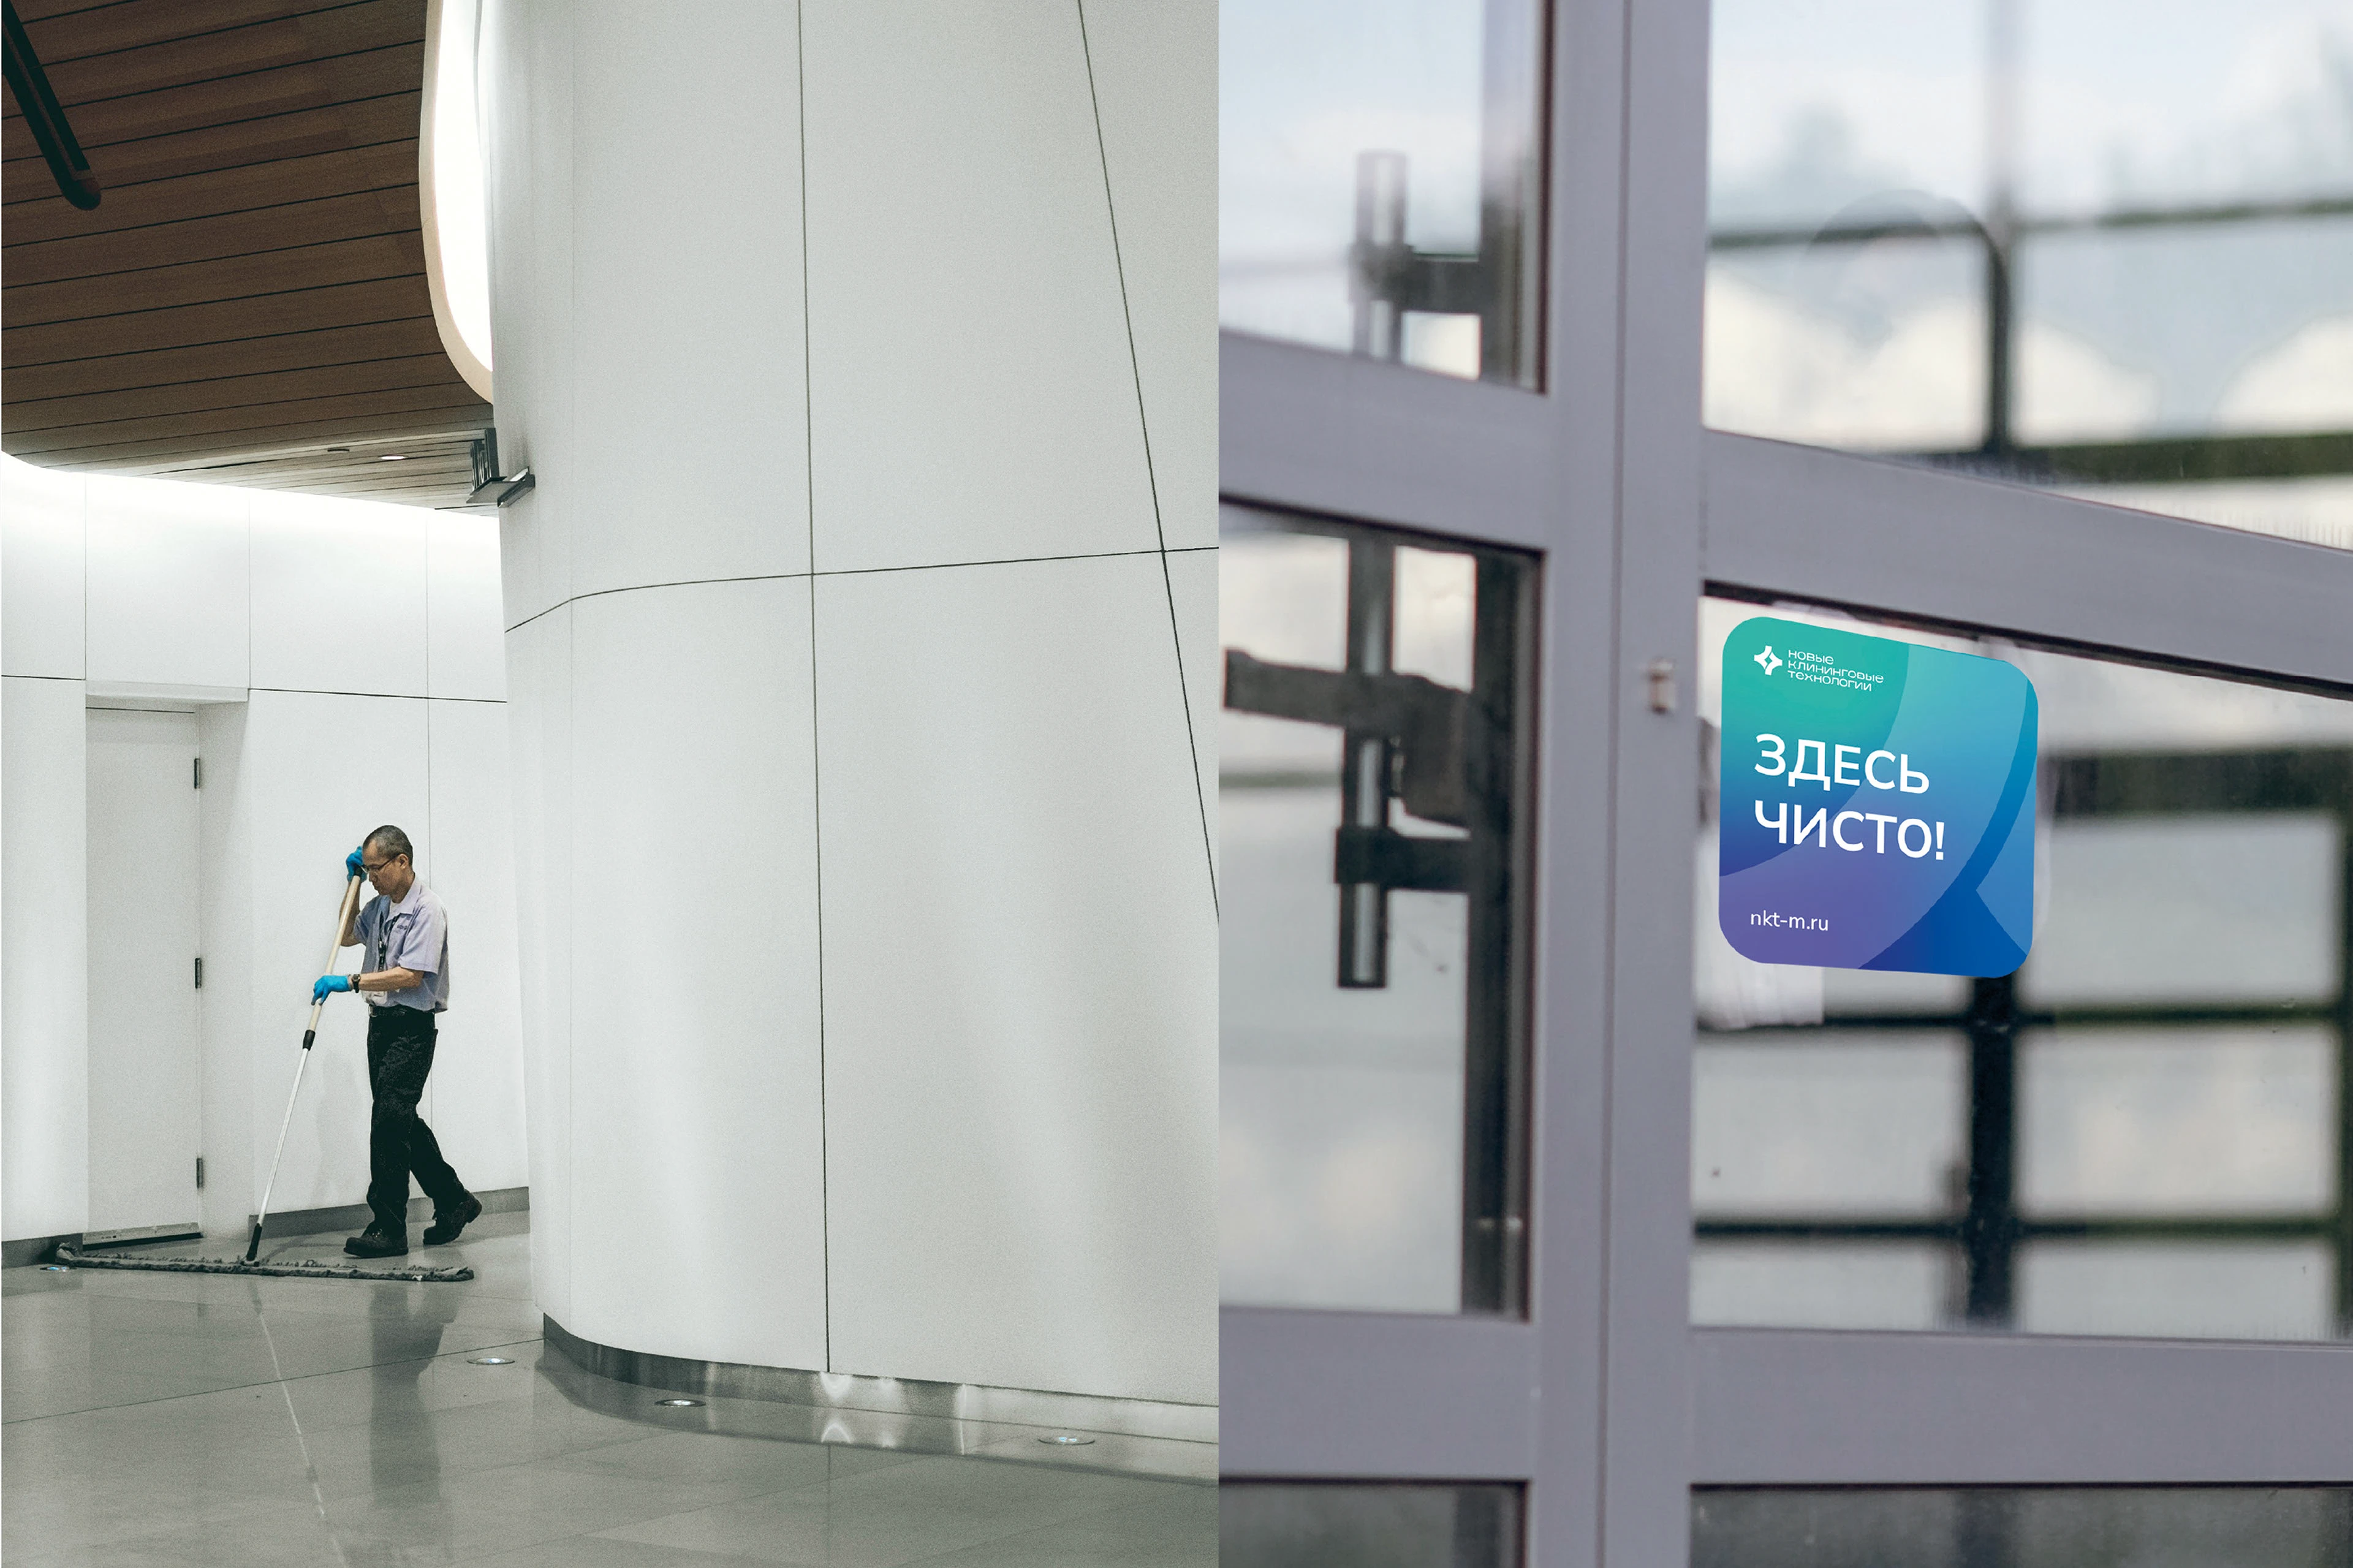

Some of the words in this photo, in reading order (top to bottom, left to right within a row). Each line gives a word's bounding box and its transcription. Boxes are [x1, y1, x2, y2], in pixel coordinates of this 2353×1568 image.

[1754, 733, 1930, 794] ЗДЕСЬ
[1755, 800, 1944, 860] ЧИСТО!
[1751, 909, 1828, 931] nkt-m.ru
